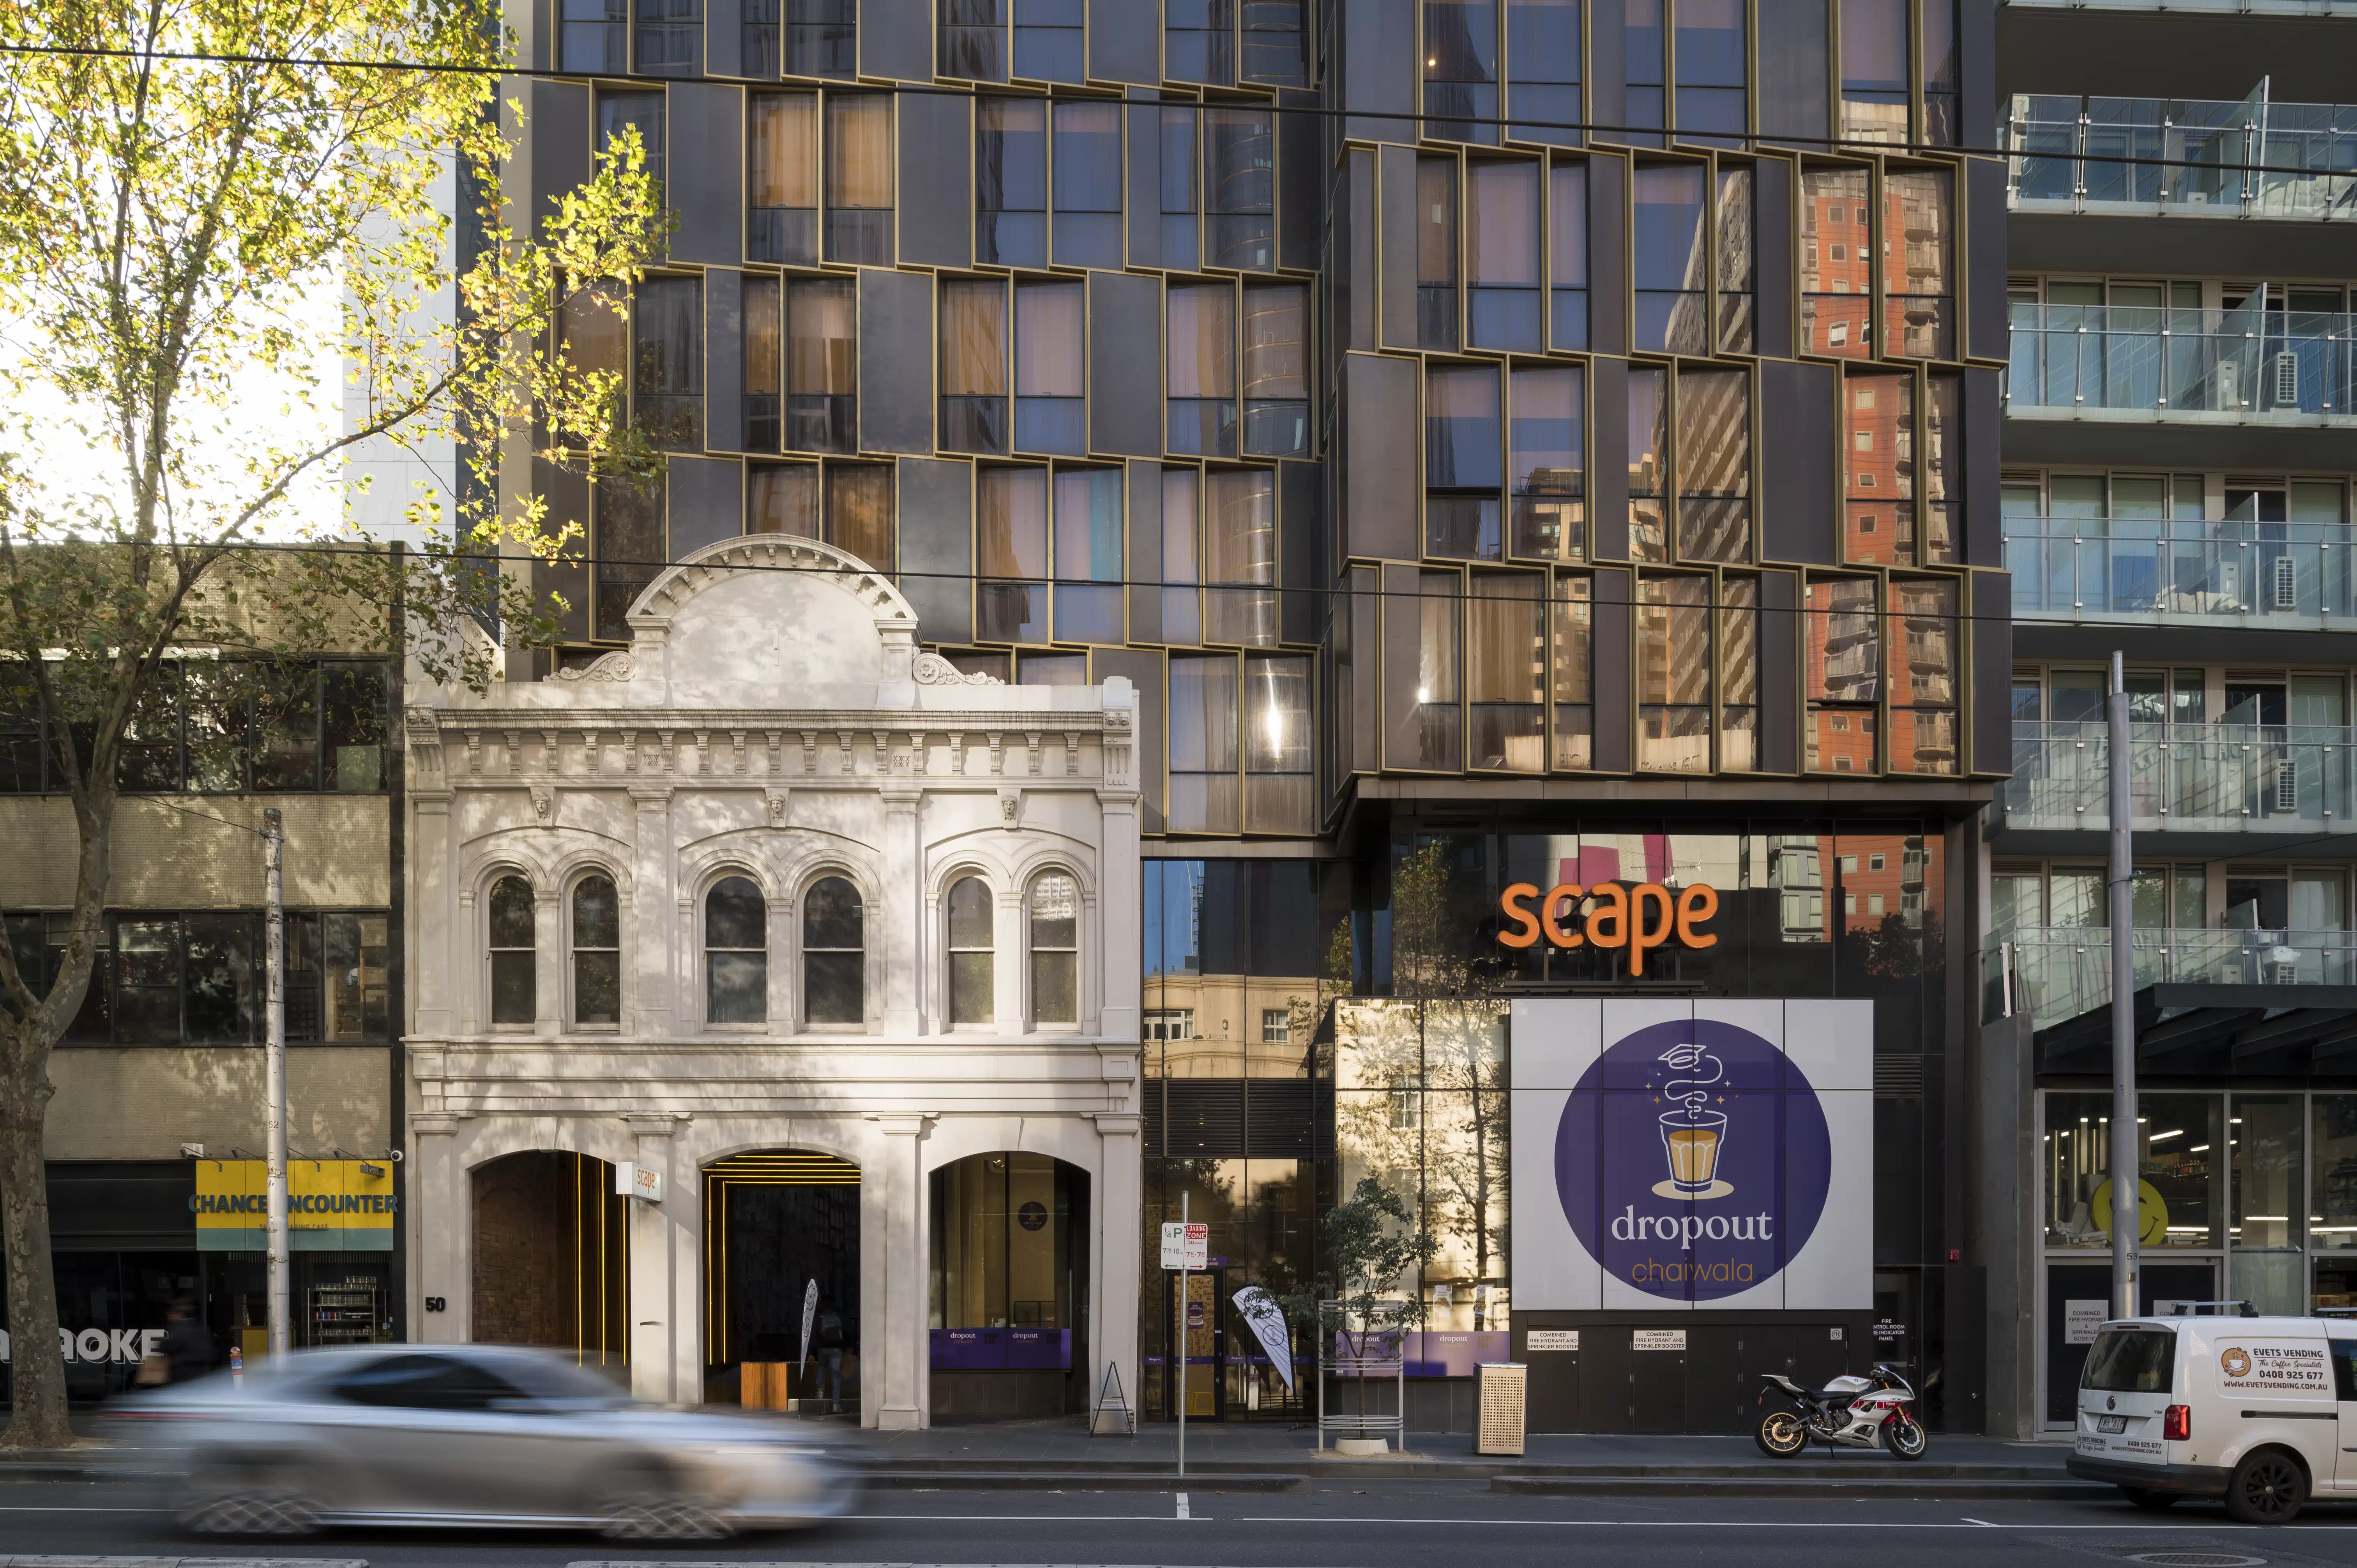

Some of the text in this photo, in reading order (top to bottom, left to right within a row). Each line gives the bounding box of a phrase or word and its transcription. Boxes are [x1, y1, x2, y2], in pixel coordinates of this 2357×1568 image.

[1497, 882, 1719, 976] scape
[637, 1168, 655, 1195] scape
[188, 1194, 398, 1213] CHANCE NCOUNTER
[1173, 1227, 1182, 1238] P
[1611, 1204, 1773, 1250] dropout
[1632, 1257, 1753, 1282] chaiwala
[425, 1297, 446, 1312] 50
[2253, 1348, 2323, 1358] EVETS VENDING
[2258, 1359, 2322, 1370] The Coffee Specialists
[2259, 1370, 2283, 1379] 0408
[2286, 1371, 2304, 1379] 925
[2224, 1381, 2328, 1390] WWW.EVETSVENDING.COM.AU
